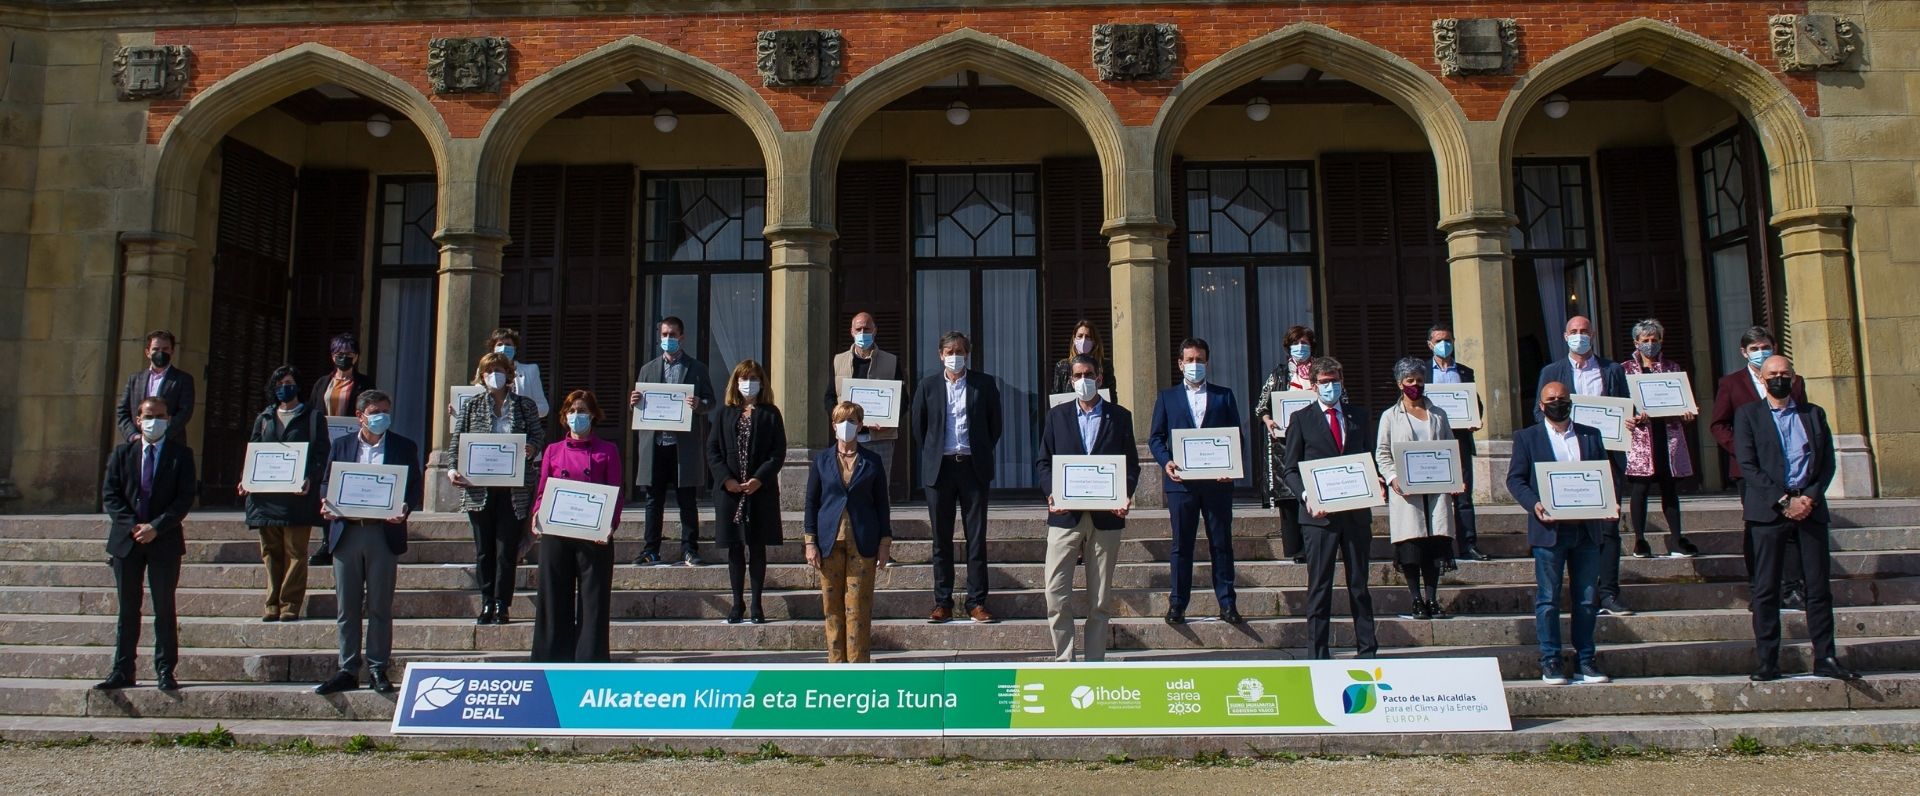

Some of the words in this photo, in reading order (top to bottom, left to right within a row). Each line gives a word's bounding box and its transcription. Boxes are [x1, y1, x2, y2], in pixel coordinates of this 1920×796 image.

[468, 679, 534, 693] BASQUE
[1166, 679, 1195, 690] udal
[1096, 686, 1141, 701] ihobe
[1167, 691, 1201, 701] sarea
[1383, 695, 1408, 703] Pacto
[1422, 694, 1436, 702] las
[1437, 693, 1477, 702] Alcaldías
[465, 694, 521, 706] GREEN
[579, 688, 686, 708] Alkateen
[693, 689, 755, 708] Klima
[762, 692, 797, 708] eta
[804, 689, 889, 714] Energia
[896, 689, 957, 708] Ituna
[462, 707, 505, 720] DEAL
[1168, 702, 1202, 715] 2030
[1384, 706, 1404, 714] para
[1414, 704, 1439, 712] Clima
[1447, 704, 1455, 712] la
[1456, 704, 1488, 713] Energía
[1385, 715, 1431, 723] EUROPA
